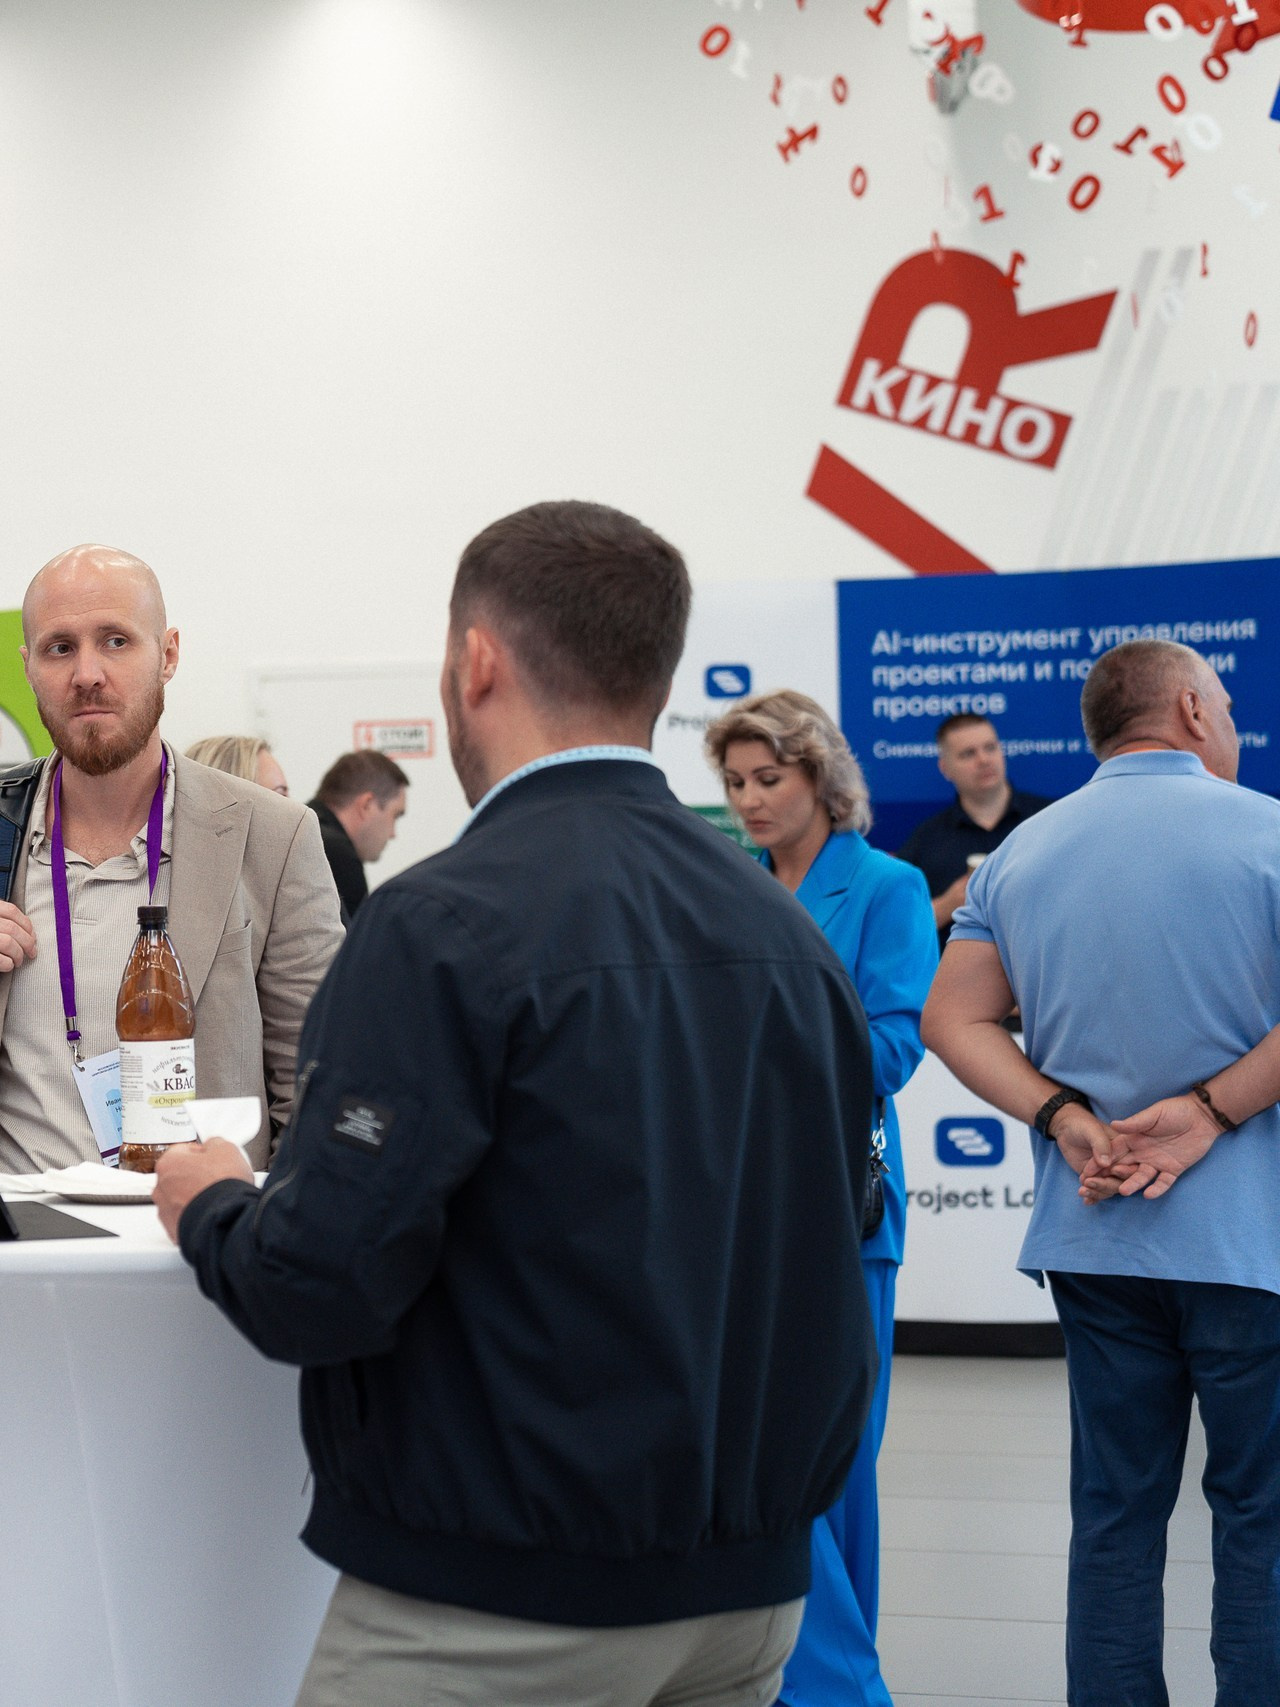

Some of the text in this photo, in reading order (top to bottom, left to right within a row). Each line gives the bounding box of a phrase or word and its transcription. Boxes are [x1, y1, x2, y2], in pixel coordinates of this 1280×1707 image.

[850, 357, 1056, 461] КИНО
[872, 618, 1257, 659] AI-инструмент управления
[872, 661, 1027, 692] проектами
[1033, 660, 1053, 681] и
[872, 692, 1007, 723] проектов
[872, 739, 939, 760] Снижа
[163, 1075, 194, 1091] КВАС
[906, 1184, 996, 1216] roject
